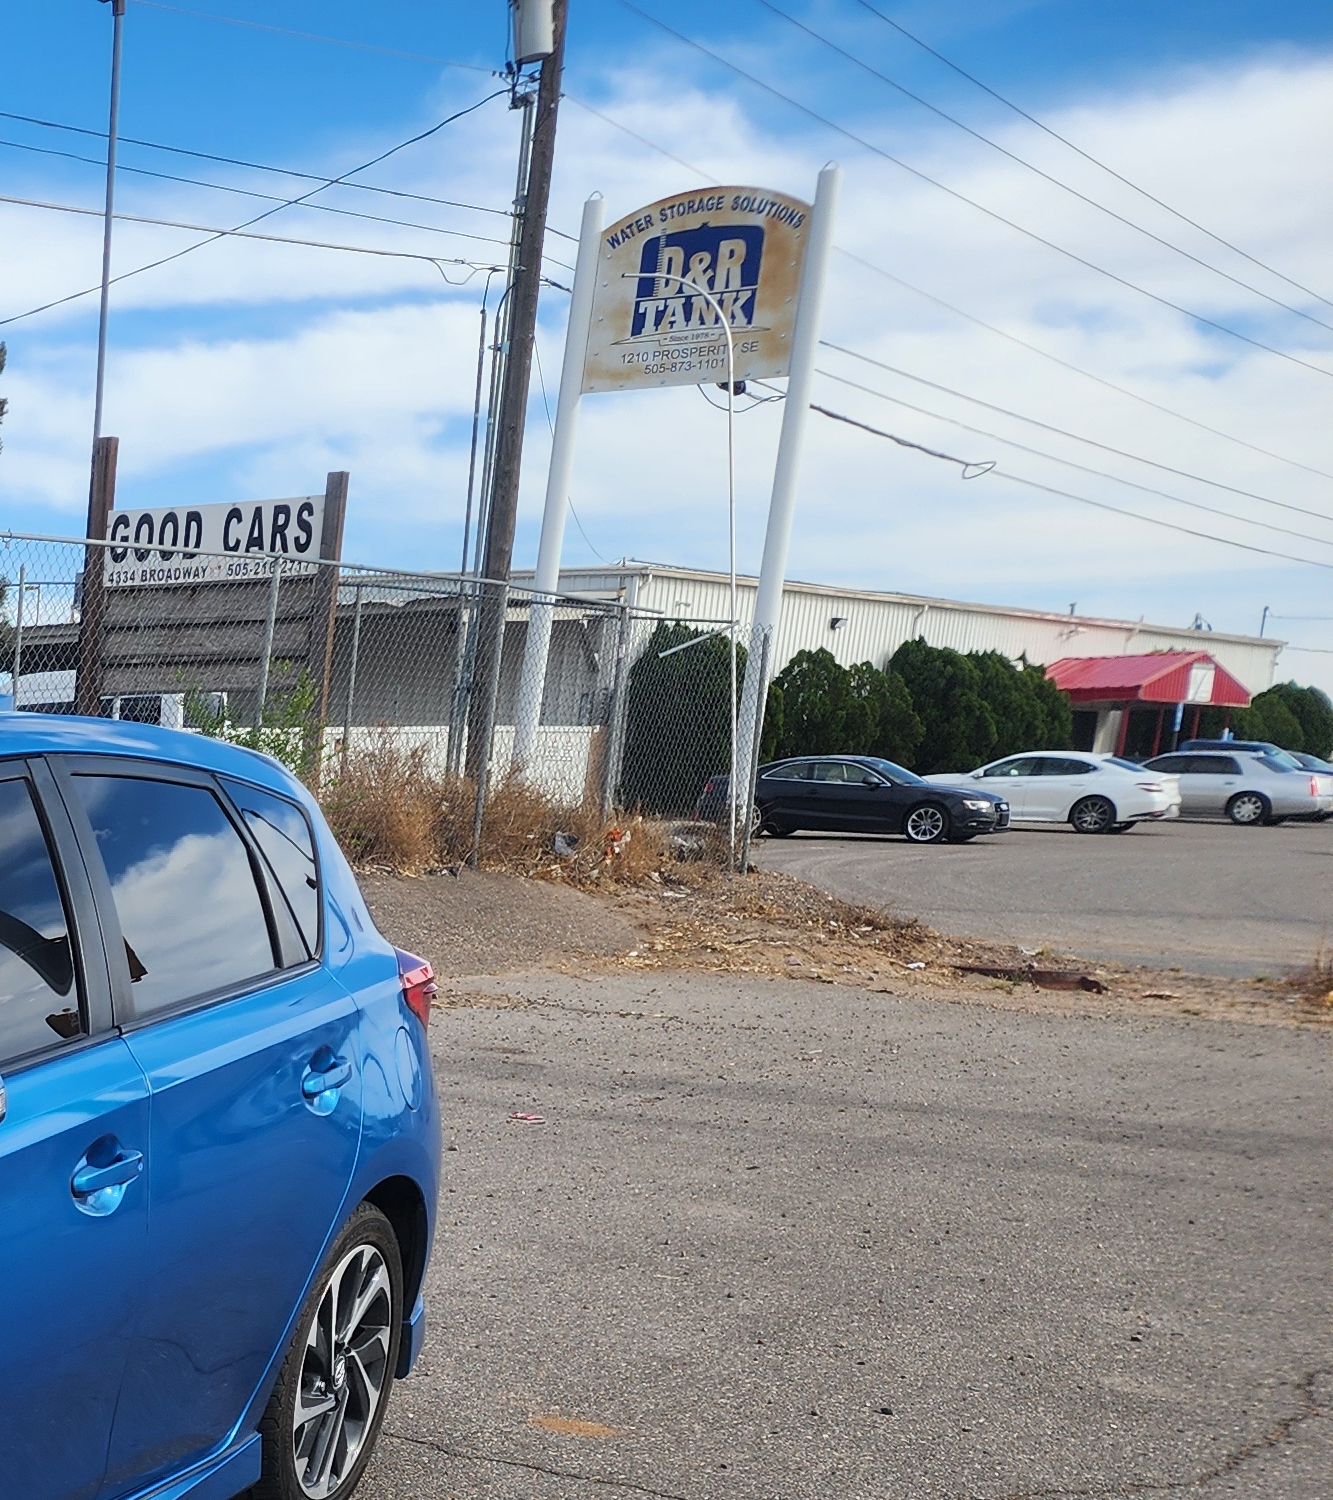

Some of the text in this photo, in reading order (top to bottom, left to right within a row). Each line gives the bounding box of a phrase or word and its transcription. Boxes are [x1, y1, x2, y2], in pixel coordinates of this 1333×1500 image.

[606, 196, 807, 250] WATER STORAGE SOLUTIONS
[657, 239, 747, 297] D&R
[638, 290, 754, 333] TANK
[621, 352, 649, 364] 1210
[740, 341, 759, 353] SE
[643, 358, 726, 375] 505-873-1101
[110, 501, 315, 563] GOOD CARS
[108, 570, 136, 584] 4334
[140, 565, 208, 583] BROADWAY
